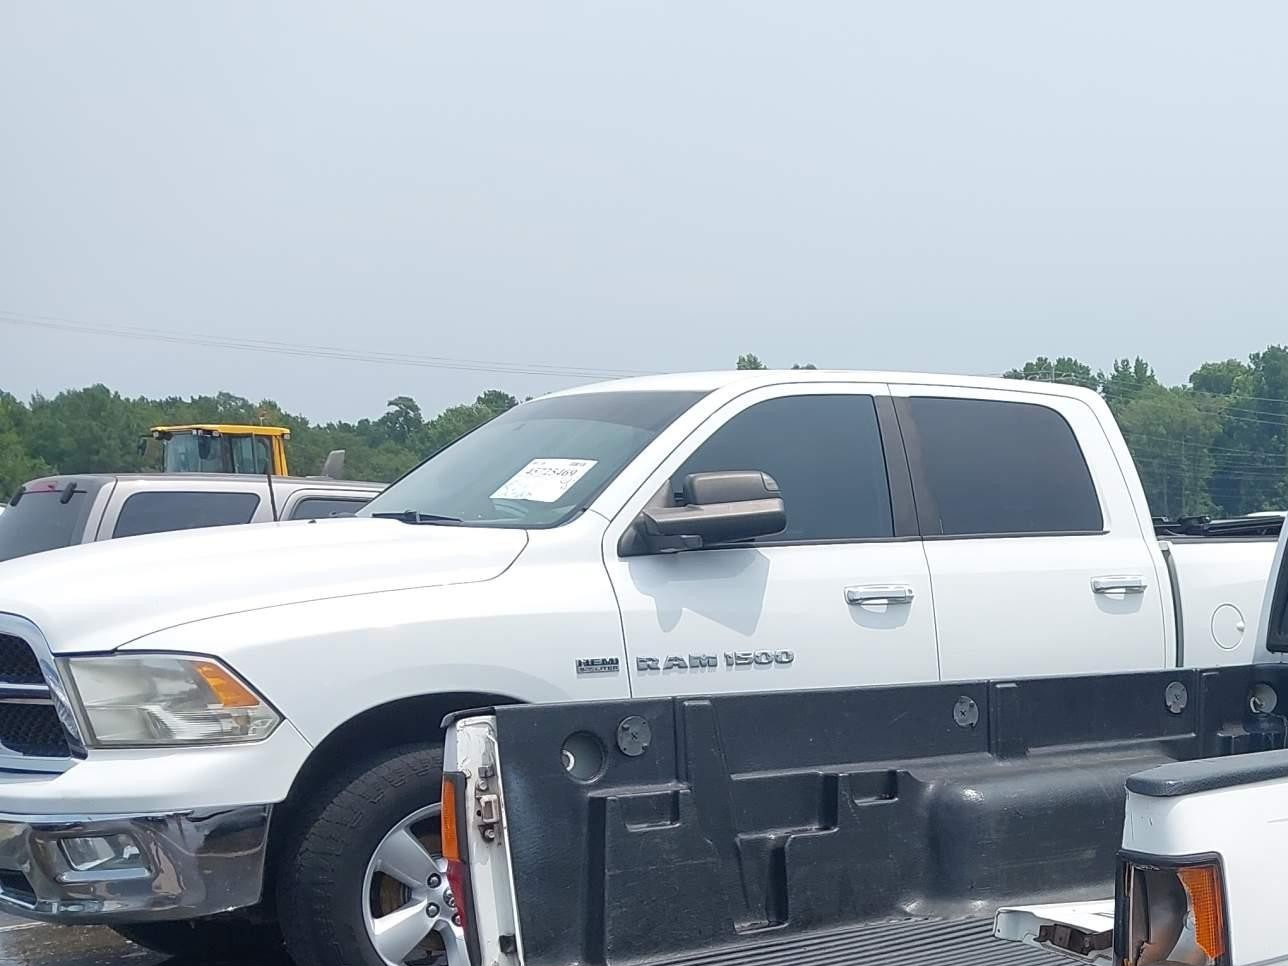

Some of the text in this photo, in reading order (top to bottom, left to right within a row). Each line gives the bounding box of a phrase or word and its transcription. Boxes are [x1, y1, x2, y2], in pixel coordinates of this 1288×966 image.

[577, 657, 620, 667] HEMI
[636, 650, 795, 671] RAM 1500
